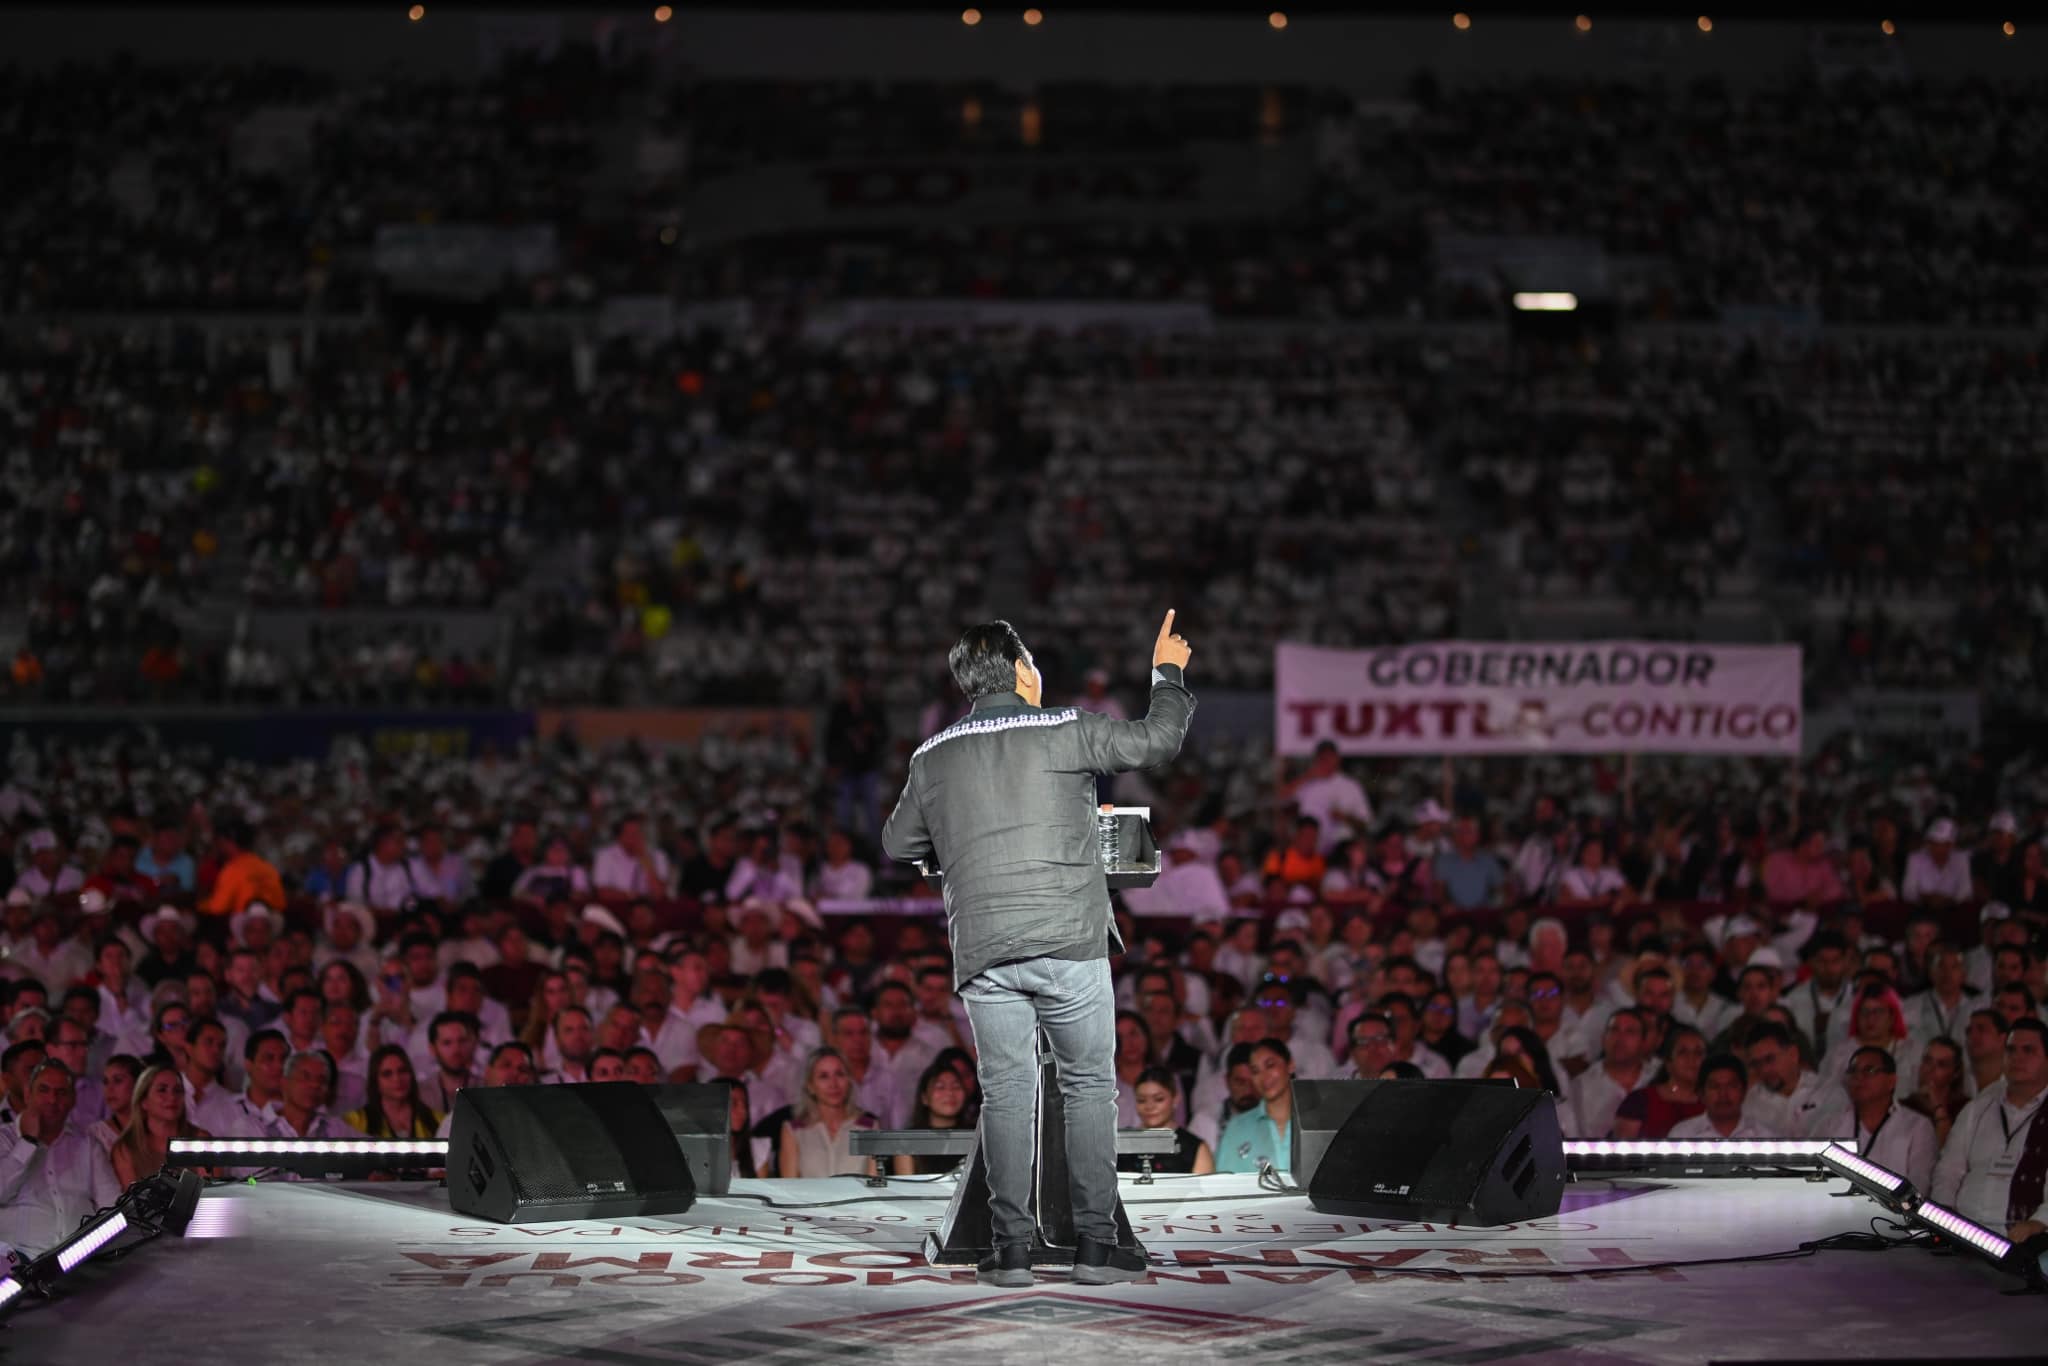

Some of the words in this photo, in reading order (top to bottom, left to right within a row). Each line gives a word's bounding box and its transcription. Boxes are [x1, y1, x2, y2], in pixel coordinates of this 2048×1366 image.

[1367, 648, 1714, 688] GOBERNADOR
[1289, 701, 1558, 740] TUXTLA
[1581, 703, 1801, 740] CONTIGO
[447, 1225, 876, 1237] CHIAPAS
[1131, 1222, 1598, 1234] GOBIERN
[381, 1270, 706, 1288] QUE
